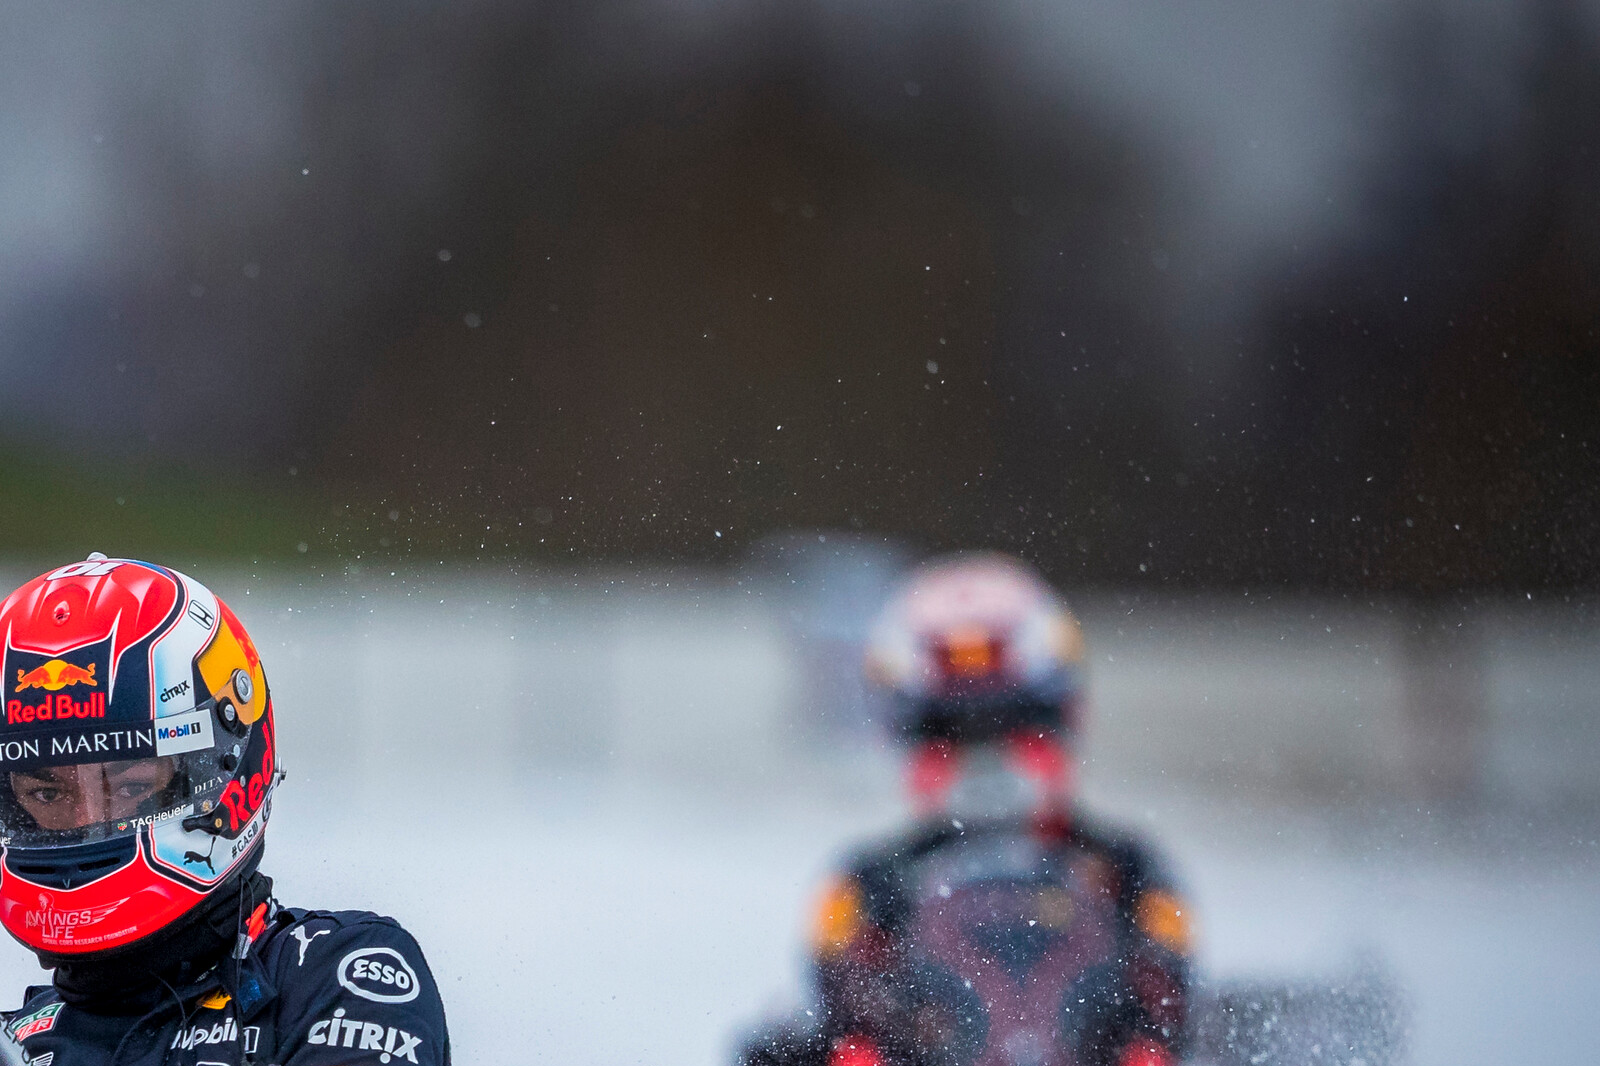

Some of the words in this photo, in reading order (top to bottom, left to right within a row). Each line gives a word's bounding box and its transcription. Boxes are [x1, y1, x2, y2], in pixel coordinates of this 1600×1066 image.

[8, 694, 52, 724] Red
[55, 692, 105, 719] Bull
[158, 724, 190, 740] Mobil
[191, 721, 201, 735] 1
[51, 729, 153, 755] MARTIN
[194, 776, 223, 795] DITA
[220, 722, 274, 831] Red
[27, 908, 91, 926] WINGS
[42, 925, 75, 939] LIFE
[170, 1017, 238, 1051] Mobil
